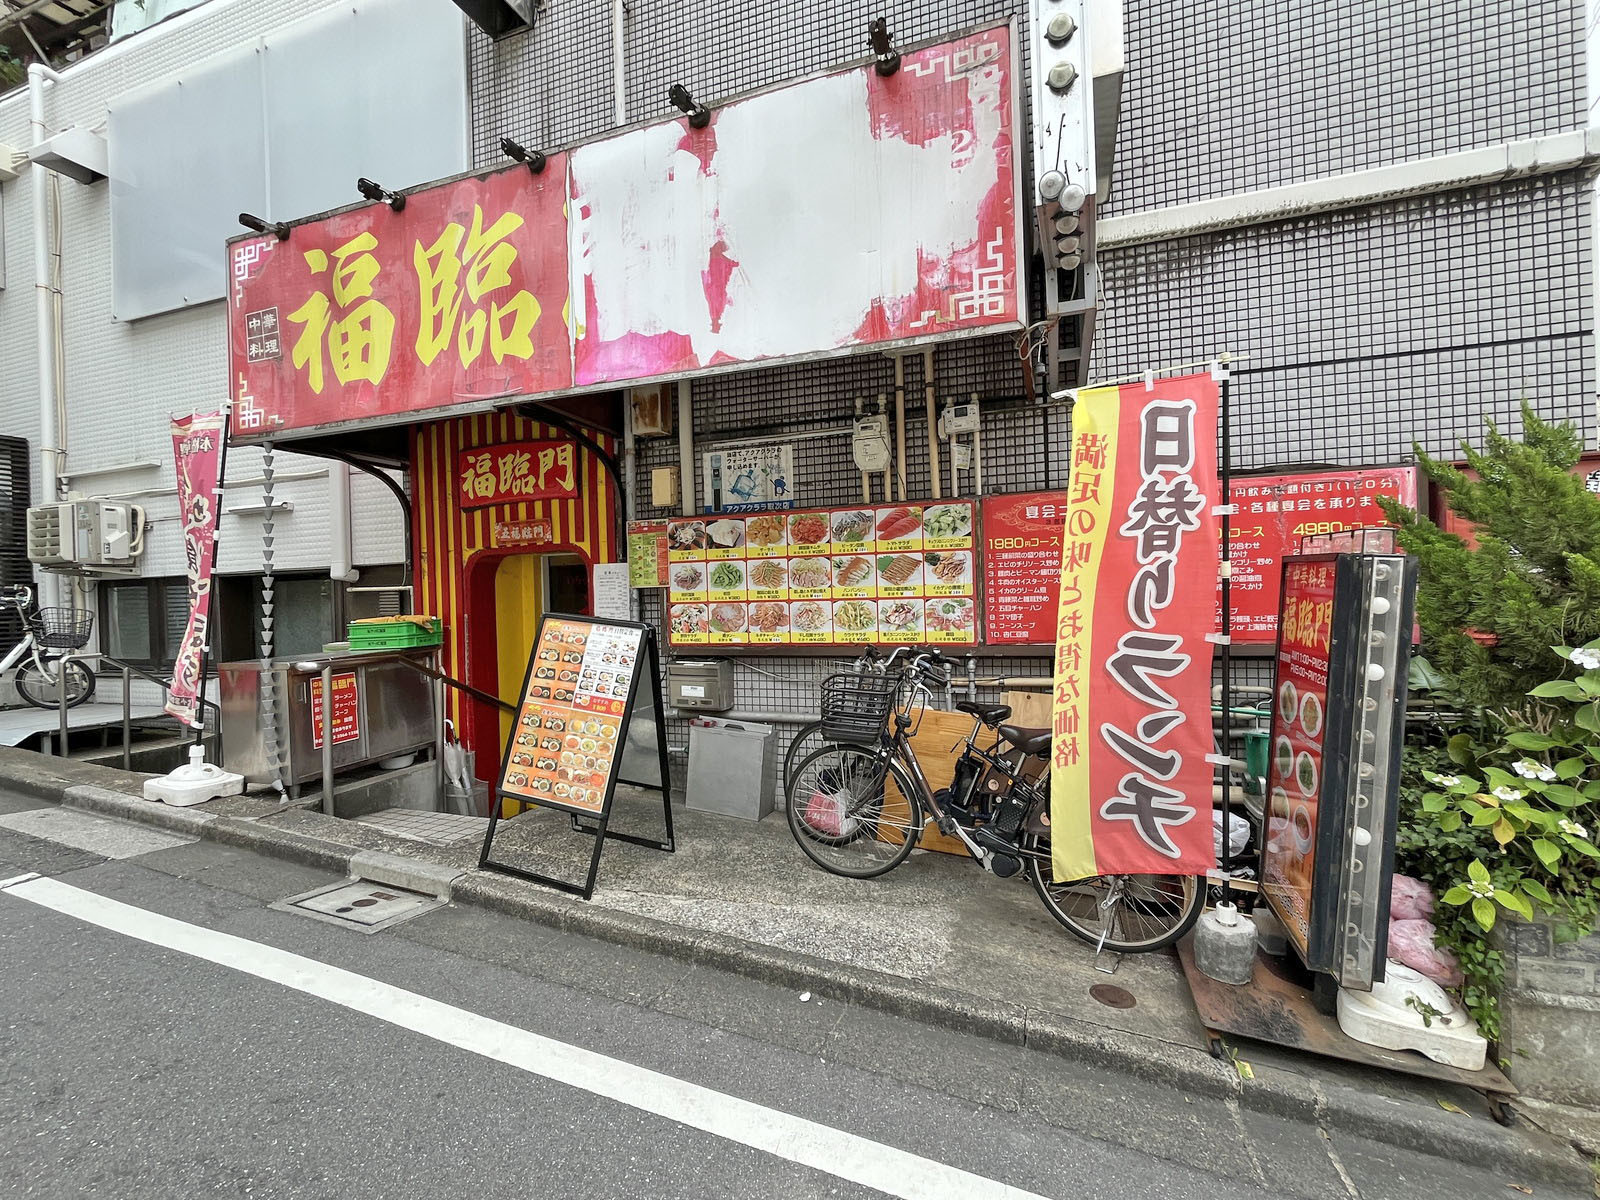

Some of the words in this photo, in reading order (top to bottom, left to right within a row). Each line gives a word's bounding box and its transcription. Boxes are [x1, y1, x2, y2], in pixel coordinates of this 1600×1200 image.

[247, 312, 279, 333] 中華
[248, 337, 280, 360] 料理
[461, 443, 575, 500] 福臨門
[726, 501, 790, 513] アクアクララ取次店
[988, 536, 1061, 551] 1980円コース
[997, 577, 1061, 586] 牛肉のオイスターソース
[1282, 596, 1333, 655] 福臨門
